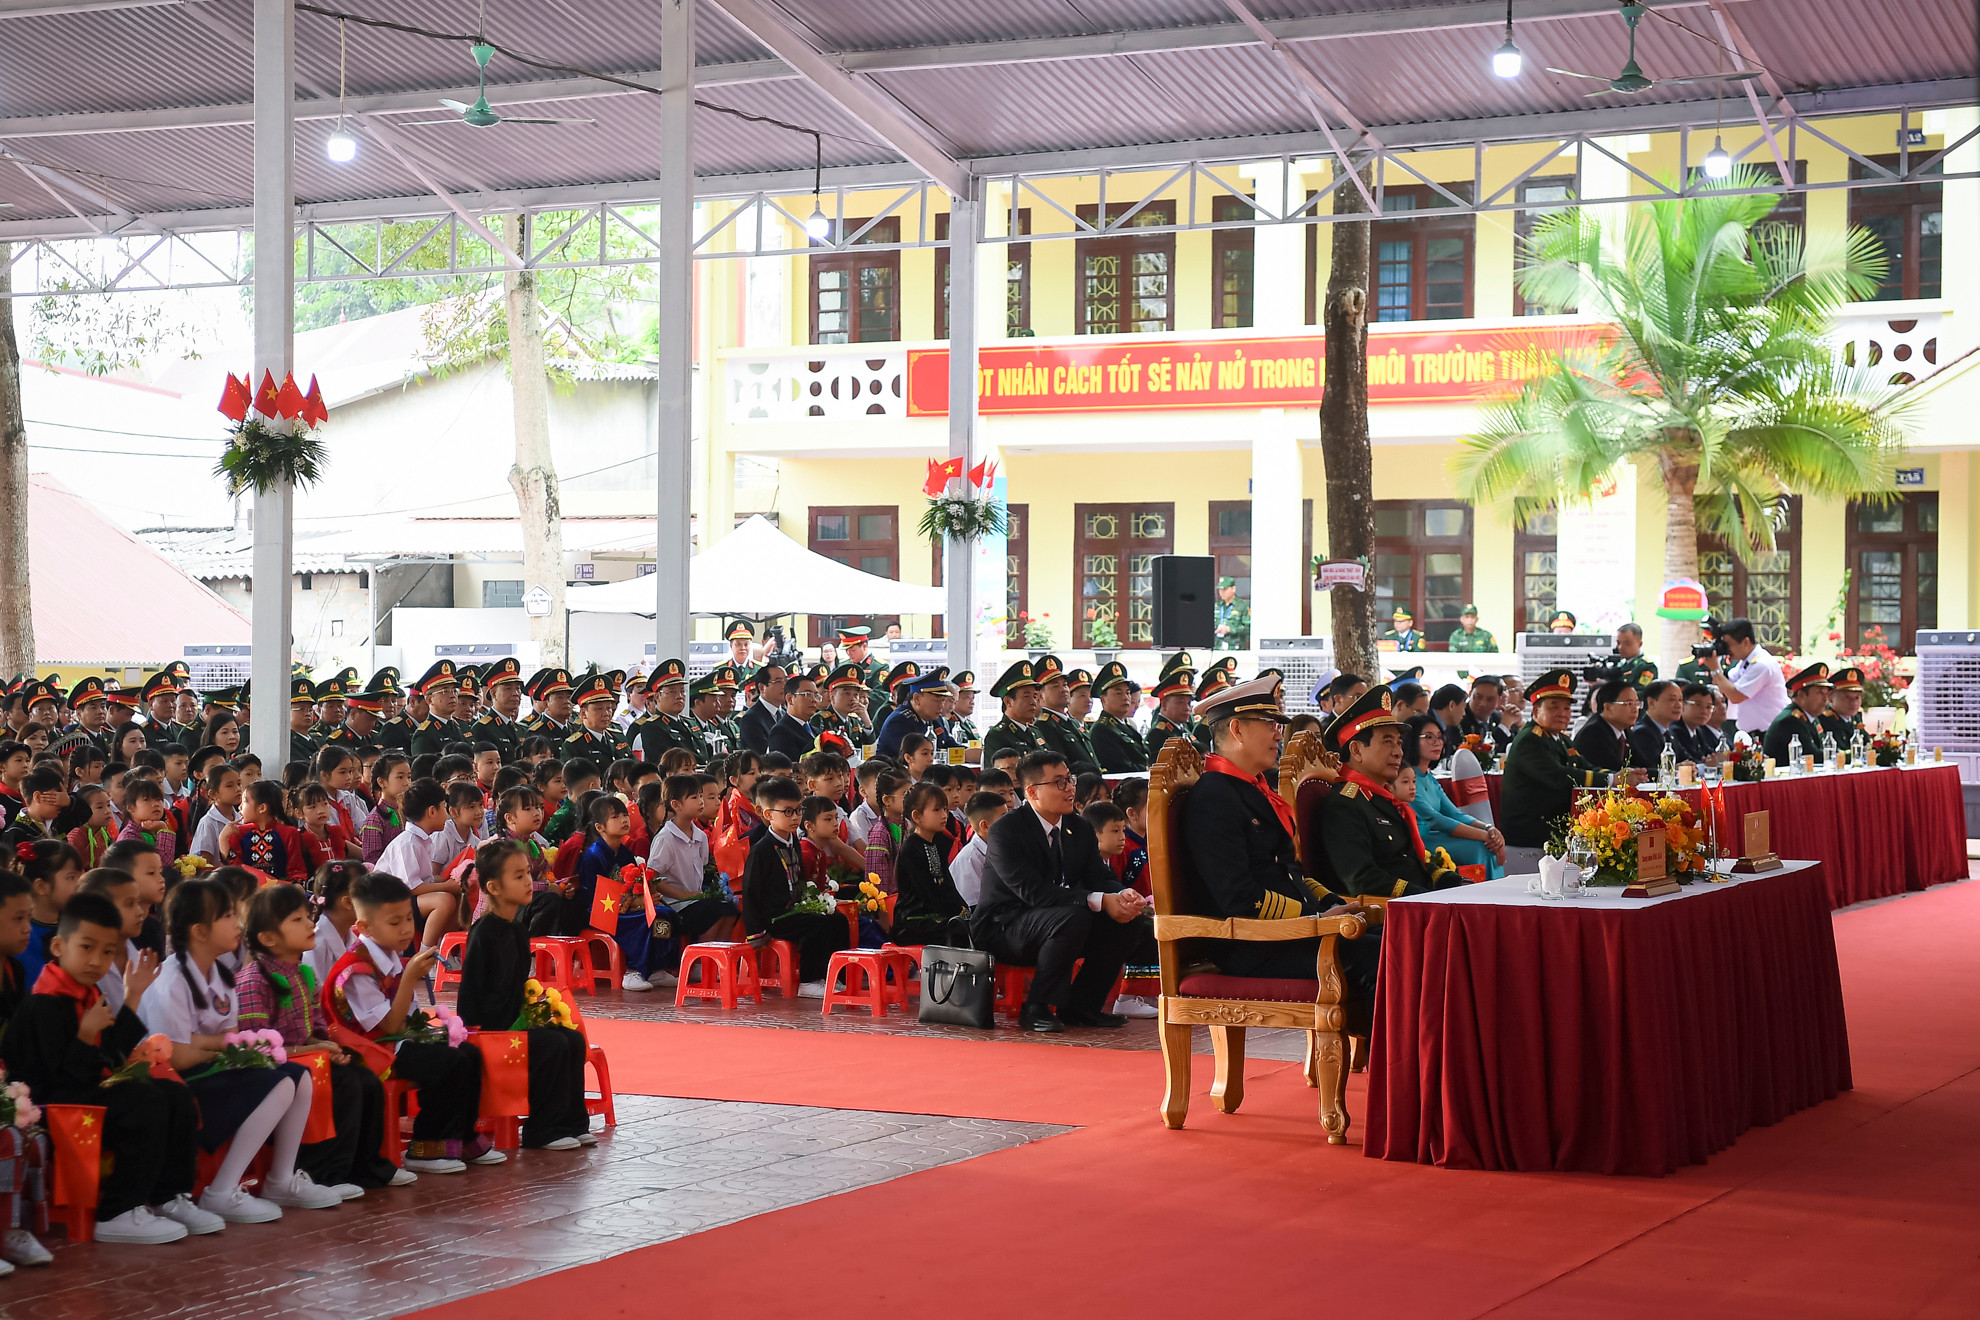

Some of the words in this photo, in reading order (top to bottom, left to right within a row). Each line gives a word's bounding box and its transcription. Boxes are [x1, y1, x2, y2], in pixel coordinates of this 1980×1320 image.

[998, 362, 1048, 396] NHÂN
[1054, 360, 1102, 394] CÁCH
[1108, 353, 1141, 393] TỐT
[1148, 357, 1171, 392] SẼ
[1176, 353, 1213, 391] NẢY
[1218, 349, 1247, 391] NỞ
[1251, 357, 1315, 388] TRONG
[1367, 348, 1406, 385] MÔI
[1412, 344, 1495, 385] TRƯỜNG
[645, 564, 656, 573] WC
